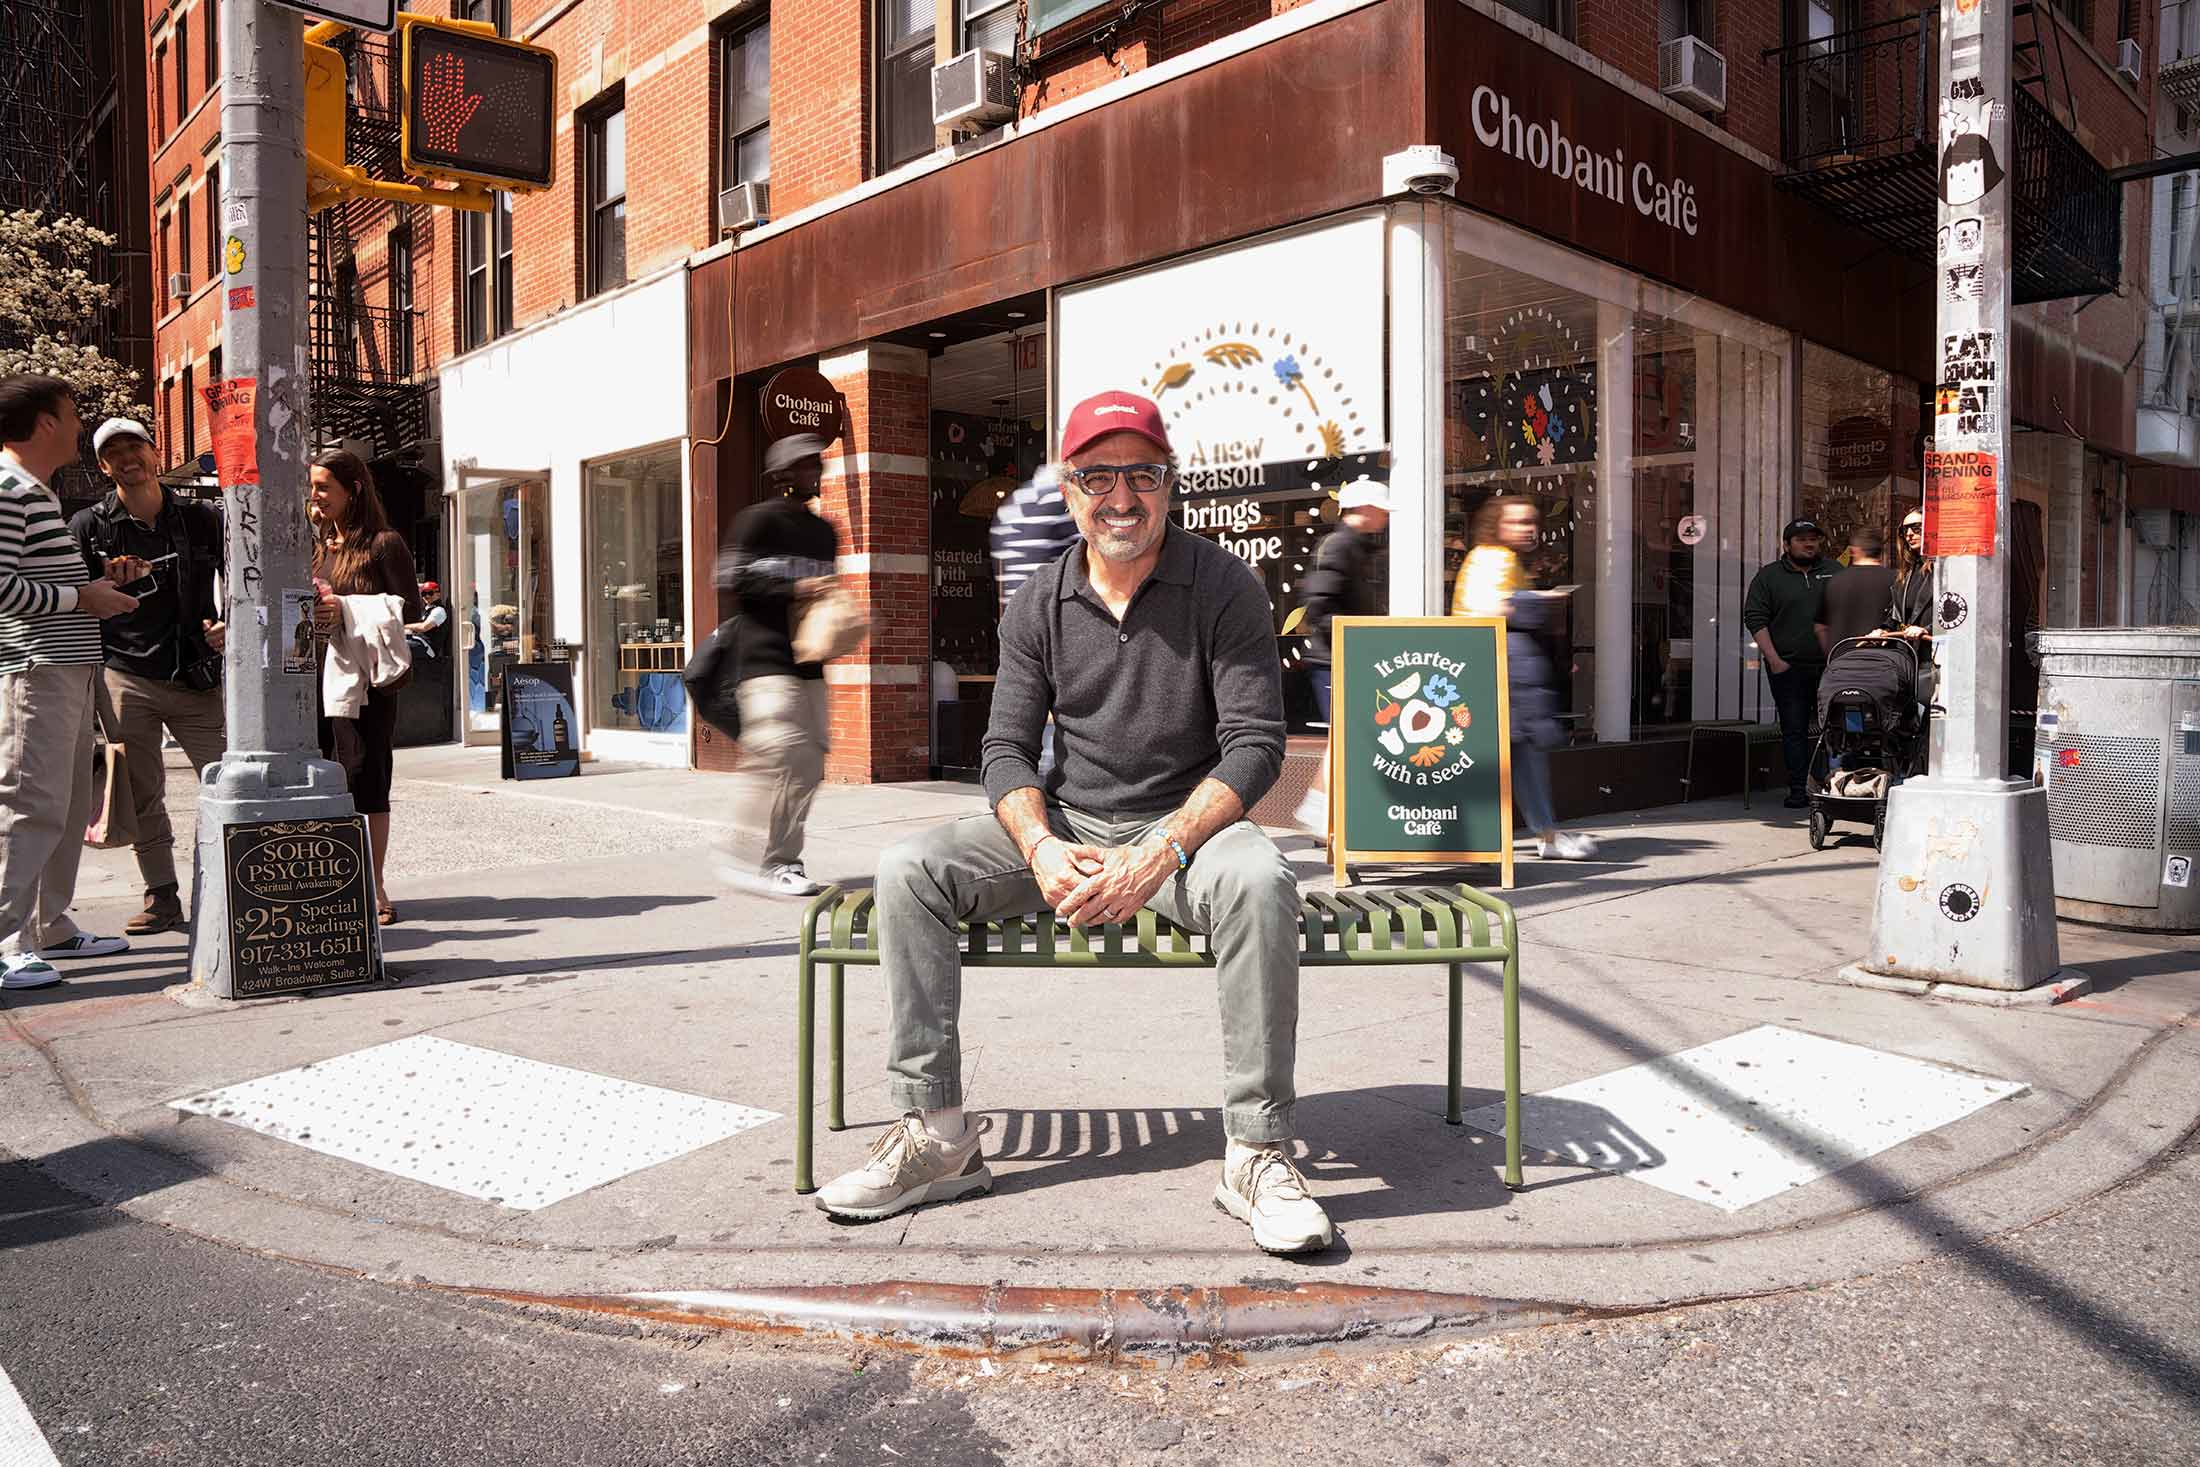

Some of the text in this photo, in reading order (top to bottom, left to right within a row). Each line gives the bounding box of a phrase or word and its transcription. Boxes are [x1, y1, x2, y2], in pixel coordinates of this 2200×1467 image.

[1471, 84, 1698, 236] Chobani Café
[775, 393, 833, 414] Chobani
[1959, 385, 1995, 413] AT
[789, 410, 820, 426] Café
[1190, 437, 1264, 467] A new
[1178, 463, 1266, 495] season
[1182, 498, 1261, 533] brings
[934, 548, 982, 564] started
[1217, 532, 1283, 568] hope
[941, 582, 974, 598] seed
[1373, 650, 1467, 679] It started
[513, 677, 541, 687] Aesop
[1371, 750, 1475, 786] with a seed
[1387, 805, 1458, 821] Chobani
[1404, 821, 1442, 836] Café
[263, 840, 335, 862] SOHO
[248, 858, 351, 883] PSYCHIC
[254, 878, 343, 894] Spiritual Awakening
[235, 898, 358, 941] $25 Special
[296, 918, 364, 936] Readings
[240, 935, 362, 965] 917-331-6511
[304, 958, 345, 970] Welcome
[241, 977, 271, 992] 424W
[330, 967, 356, 981] Suite
